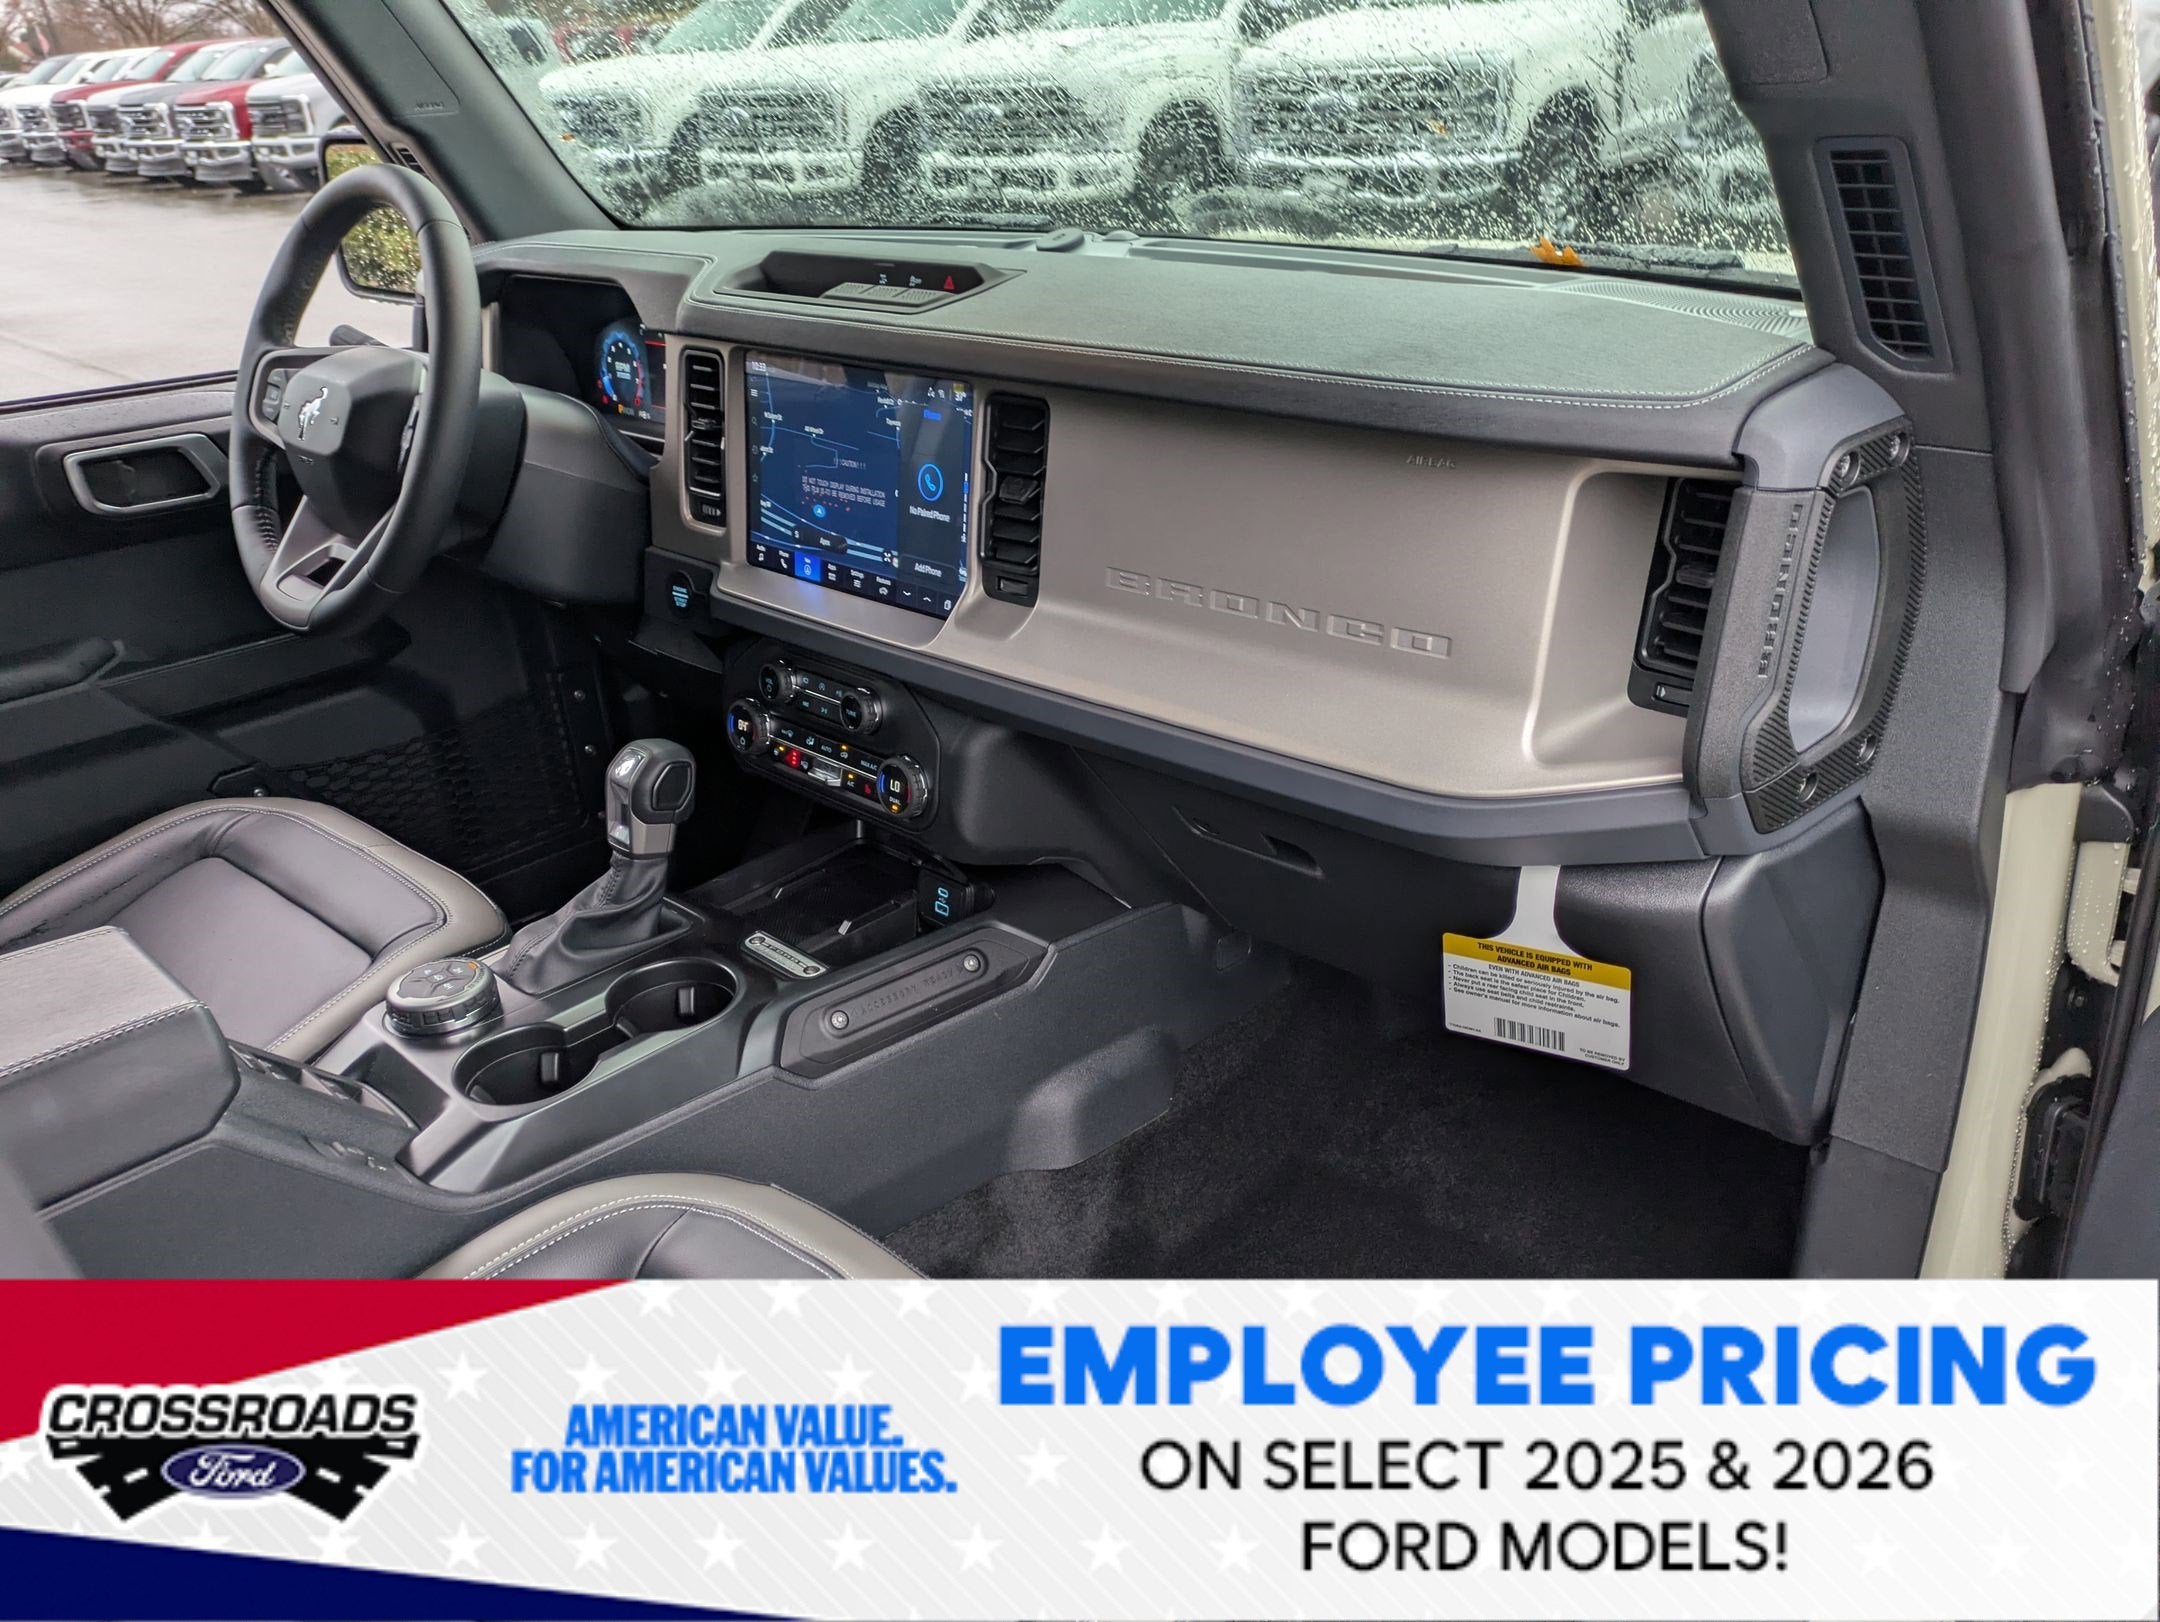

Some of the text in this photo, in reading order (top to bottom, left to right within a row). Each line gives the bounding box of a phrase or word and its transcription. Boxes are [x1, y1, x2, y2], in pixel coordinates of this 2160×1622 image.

[909, 505, 951, 522] No Paired Phone
[925, 566, 942, 578] Phone
[1758, 504, 1803, 678] BRONCO
[1104, 566, 1453, 660] BRONCO
[821, 744, 833, 754] AUTO
[890, 778, 901, 794] LO
[1477, 942, 1593, 972] THIS VEHICLE IS EQUIPPED WITH
[1497, 955, 1572, 976] ADVANCED AIR BAGS
[1452, 963, 1478, 974] Children
[1498, 973, 1515, 982] killed
[1523, 979, 1552, 989] seriously
[1552, 984, 1575, 995] injured
[1575, 989, 1584, 997] by
[1453, 969, 1464, 977] The
[1465, 971, 1479, 980] back
[1500, 978, 1510, 986] the
[1510, 981, 1530, 991] safest
[1530, 986, 1547, 995] place
[1547, 989, 1557, 997] for
[1488, 963, 1580, 988] EVEN WITH ADVANCED AIR BAGS
[861, 984, 918, 1015] ACCESSORY
[1453, 975, 1470, 984] Never
[1470, 979, 1481, 988] put
[1499, 985, 1518, 995] facing
[1518, 989, 1535, 998] child
[1535, 993, 1548, 1001] seat
[1556, 996, 1567, 1005] the
[1453, 981, 1475, 991] Always
[1475, 985, 1486, 993] use
[1486, 988, 1500, 996] seat
[1500, 990, 1516, 999] belts
[1516, 994, 1528, 1002] and
[1528, 997, 1544, 1006] child
[1453, 986, 1465, 994] See
[1465, 989, 1488, 1000] owner's
[1488, 994, 1511, 1004] manual
[1511, 999, 1521, 1007] for
[1521, 1001, 1537, 1010] more
[1537, 1005, 1574, 1018] information
[1574, 1012, 1592, 1022] about
